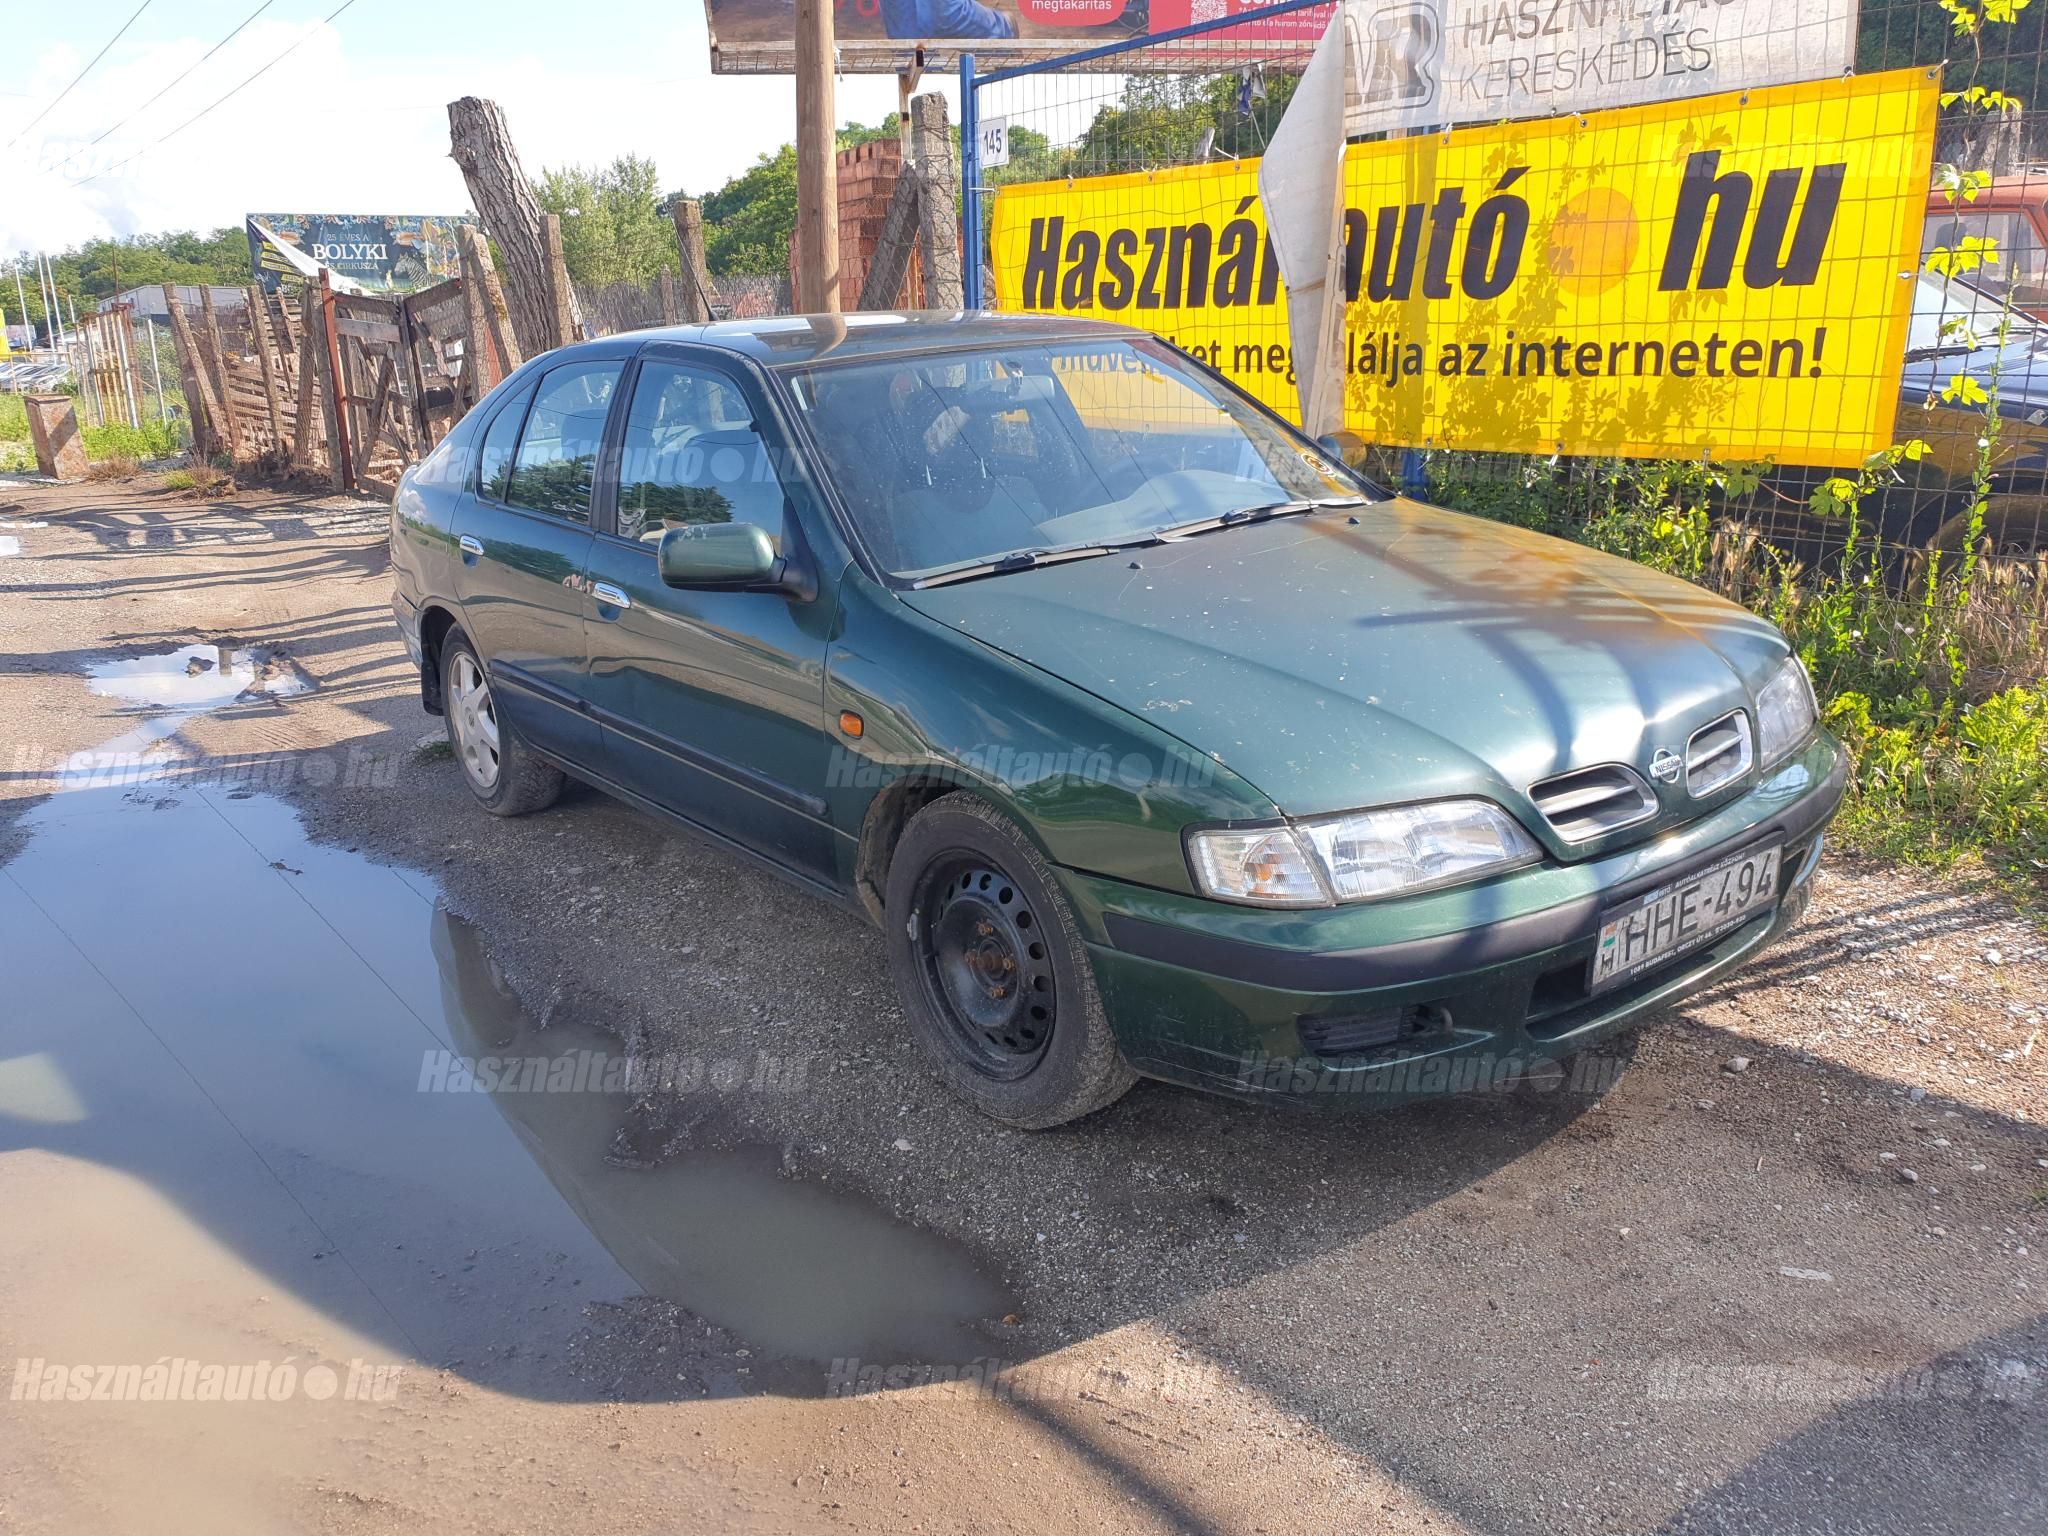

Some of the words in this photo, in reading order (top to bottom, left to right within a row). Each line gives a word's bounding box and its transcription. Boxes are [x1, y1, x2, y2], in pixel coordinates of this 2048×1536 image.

[1458, 19, 1712, 102] KERESKEDÉS
[983, 128, 1002, 156] 145
[1657, 149, 1848, 292] hu
[312, 243, 389, 260] BOLYKI
[1438, 343, 1489, 377] az
[1502, 327, 1827, 379] interneten!
[1655, 757, 1680, 774] NISSAN
[1624, 852, 1772, 962] HHE-494
